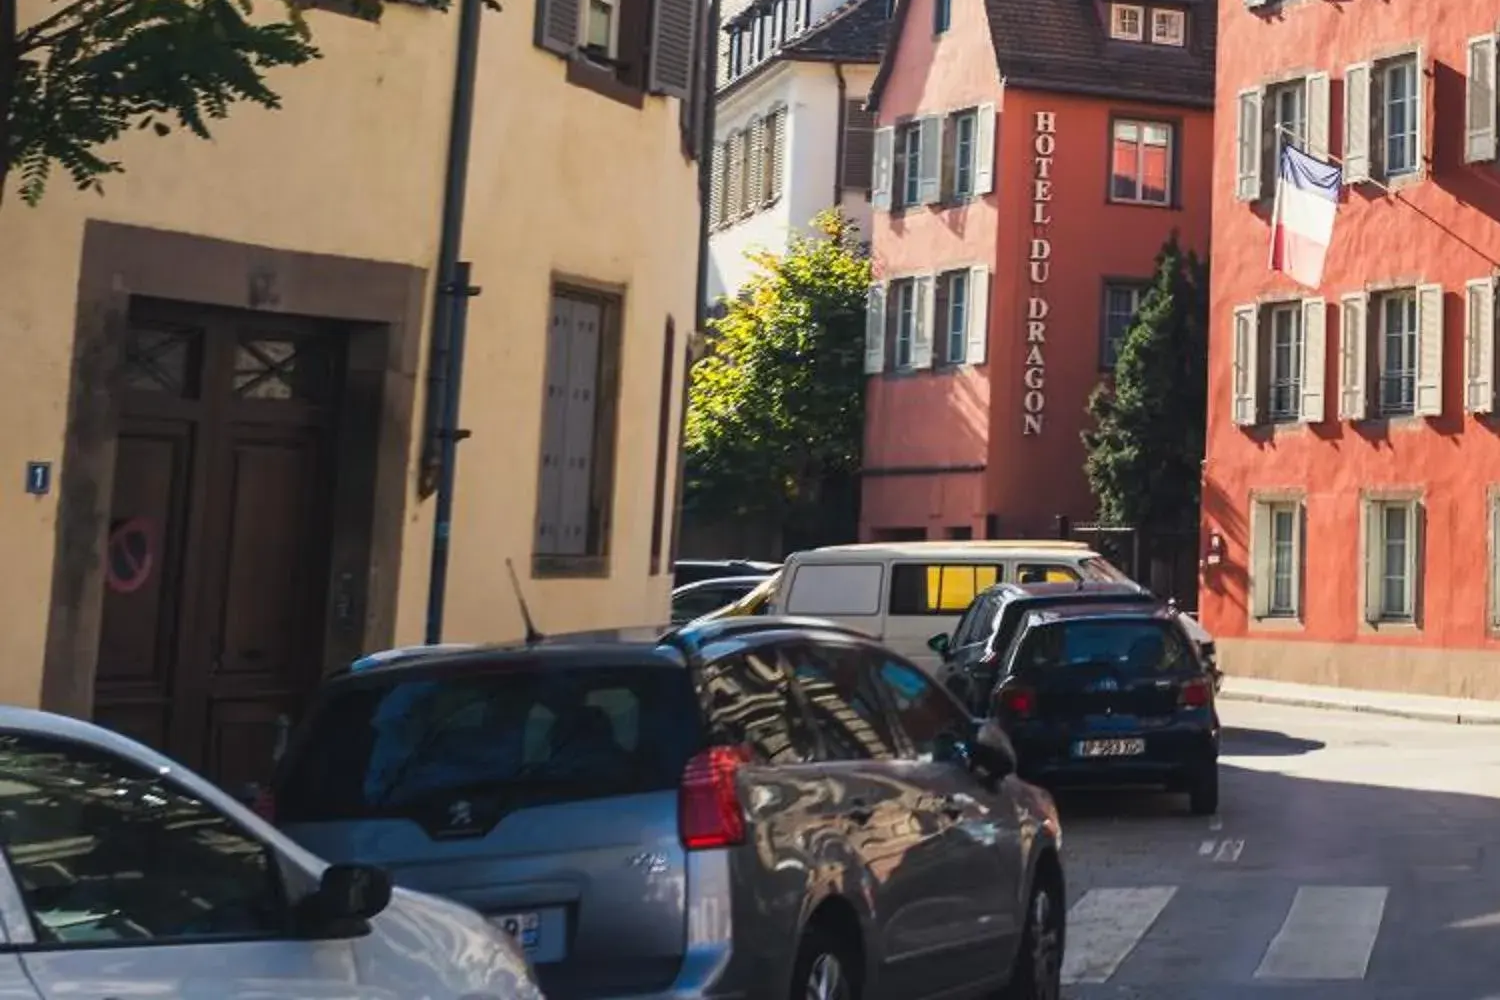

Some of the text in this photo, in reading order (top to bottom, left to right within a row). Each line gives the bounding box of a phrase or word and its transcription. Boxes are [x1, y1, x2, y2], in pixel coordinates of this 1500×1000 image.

[1023, 111, 1056, 434] HOTEL DU DRAGON
